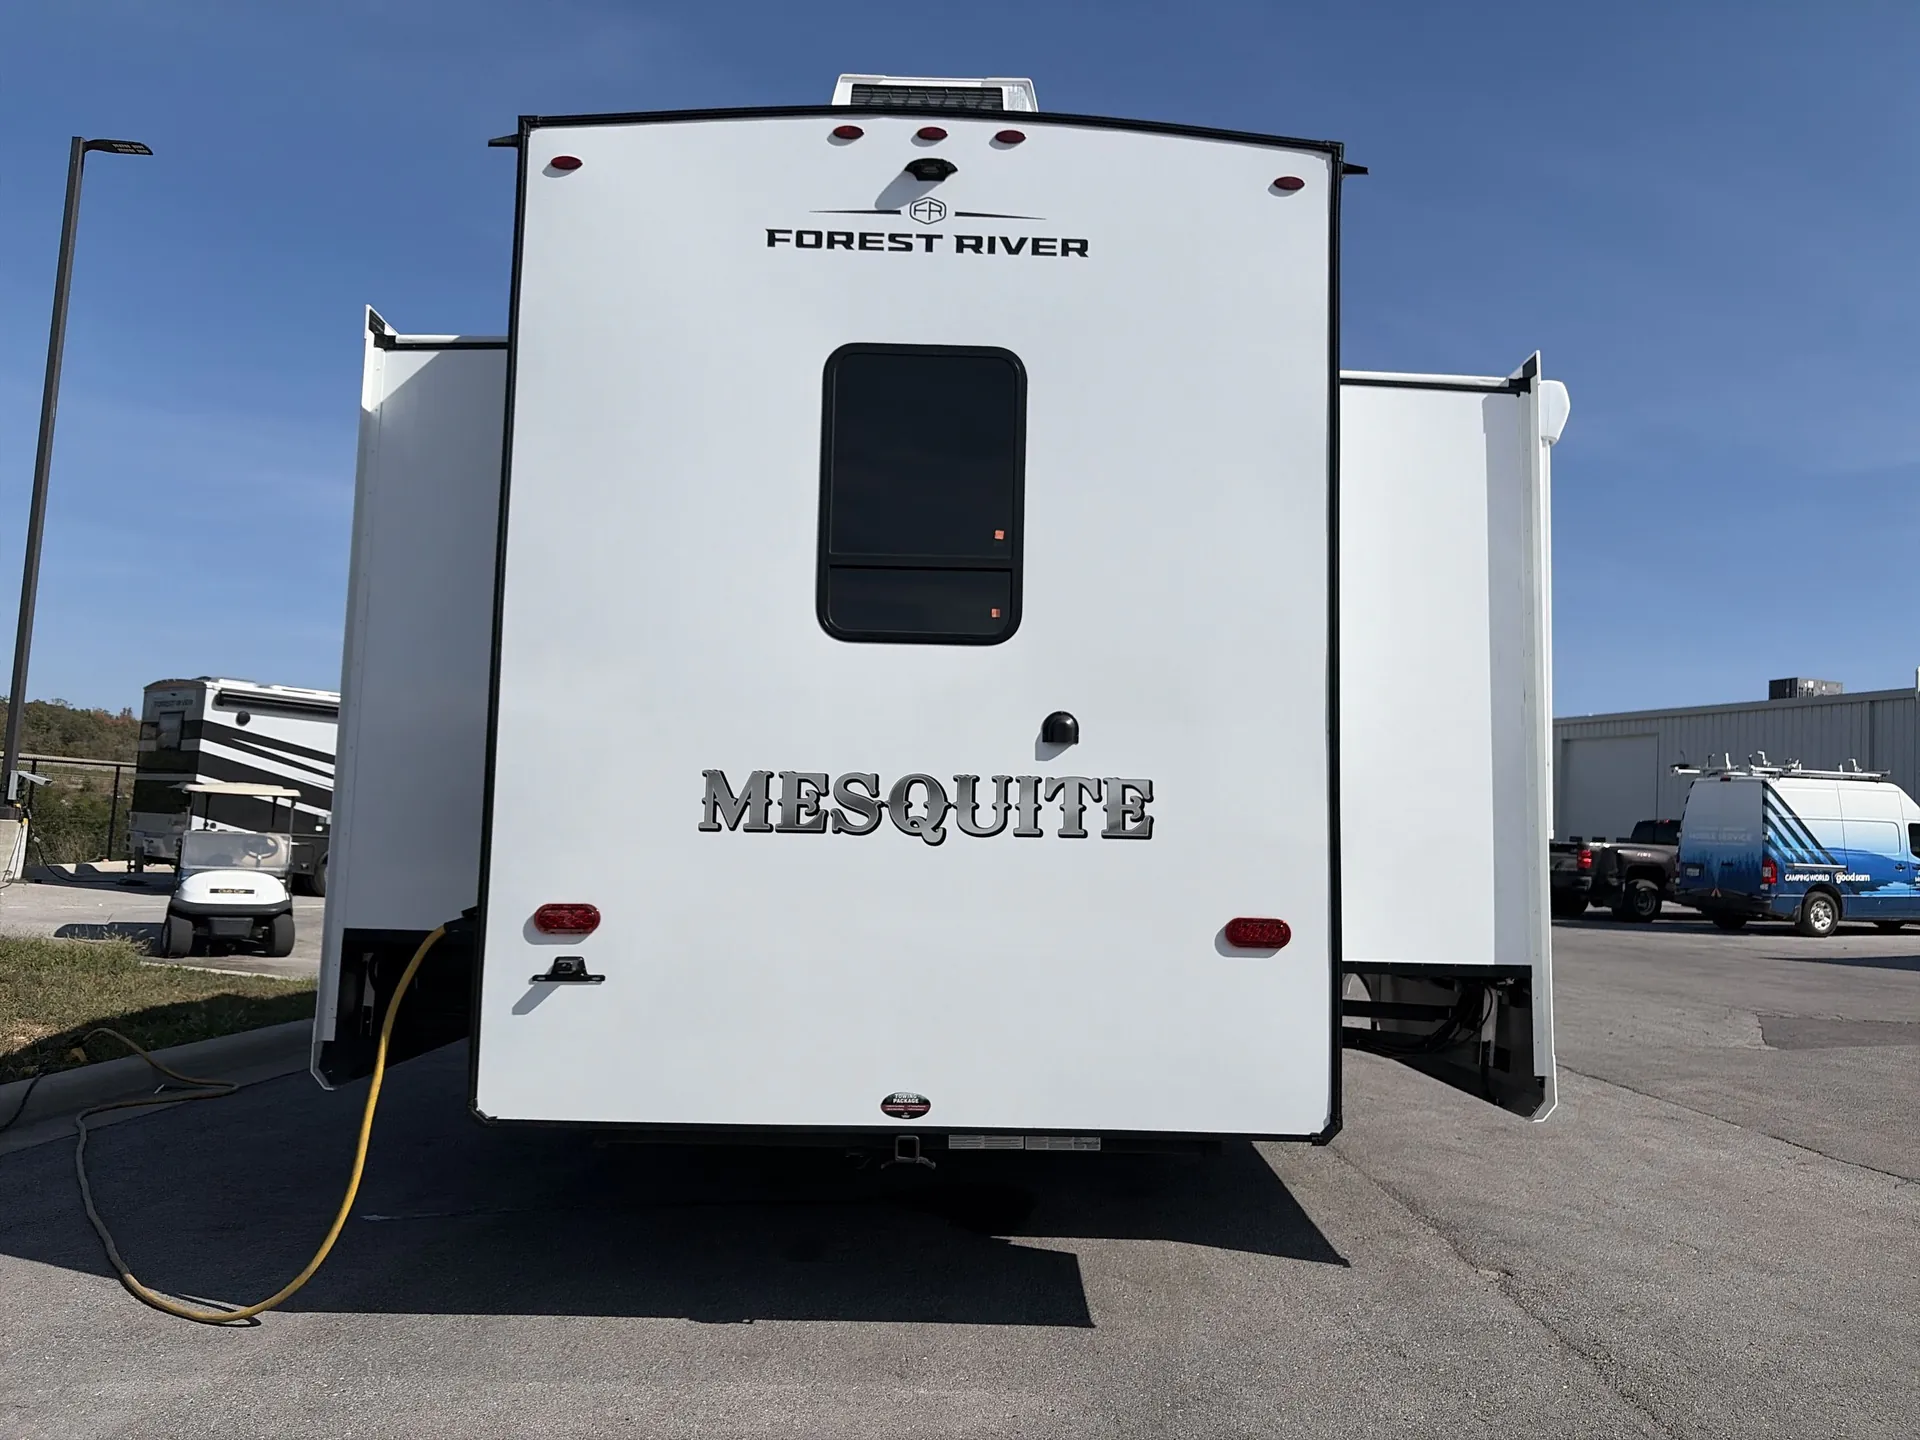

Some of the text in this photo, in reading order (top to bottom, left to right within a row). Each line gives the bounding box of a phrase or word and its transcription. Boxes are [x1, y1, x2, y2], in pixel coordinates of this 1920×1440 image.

[765, 228, 1090, 259] FOREST RIVER
[698, 768, 1155, 847] MESQUITE
[1784, 873, 1830, 882] CAMPING WORLD
